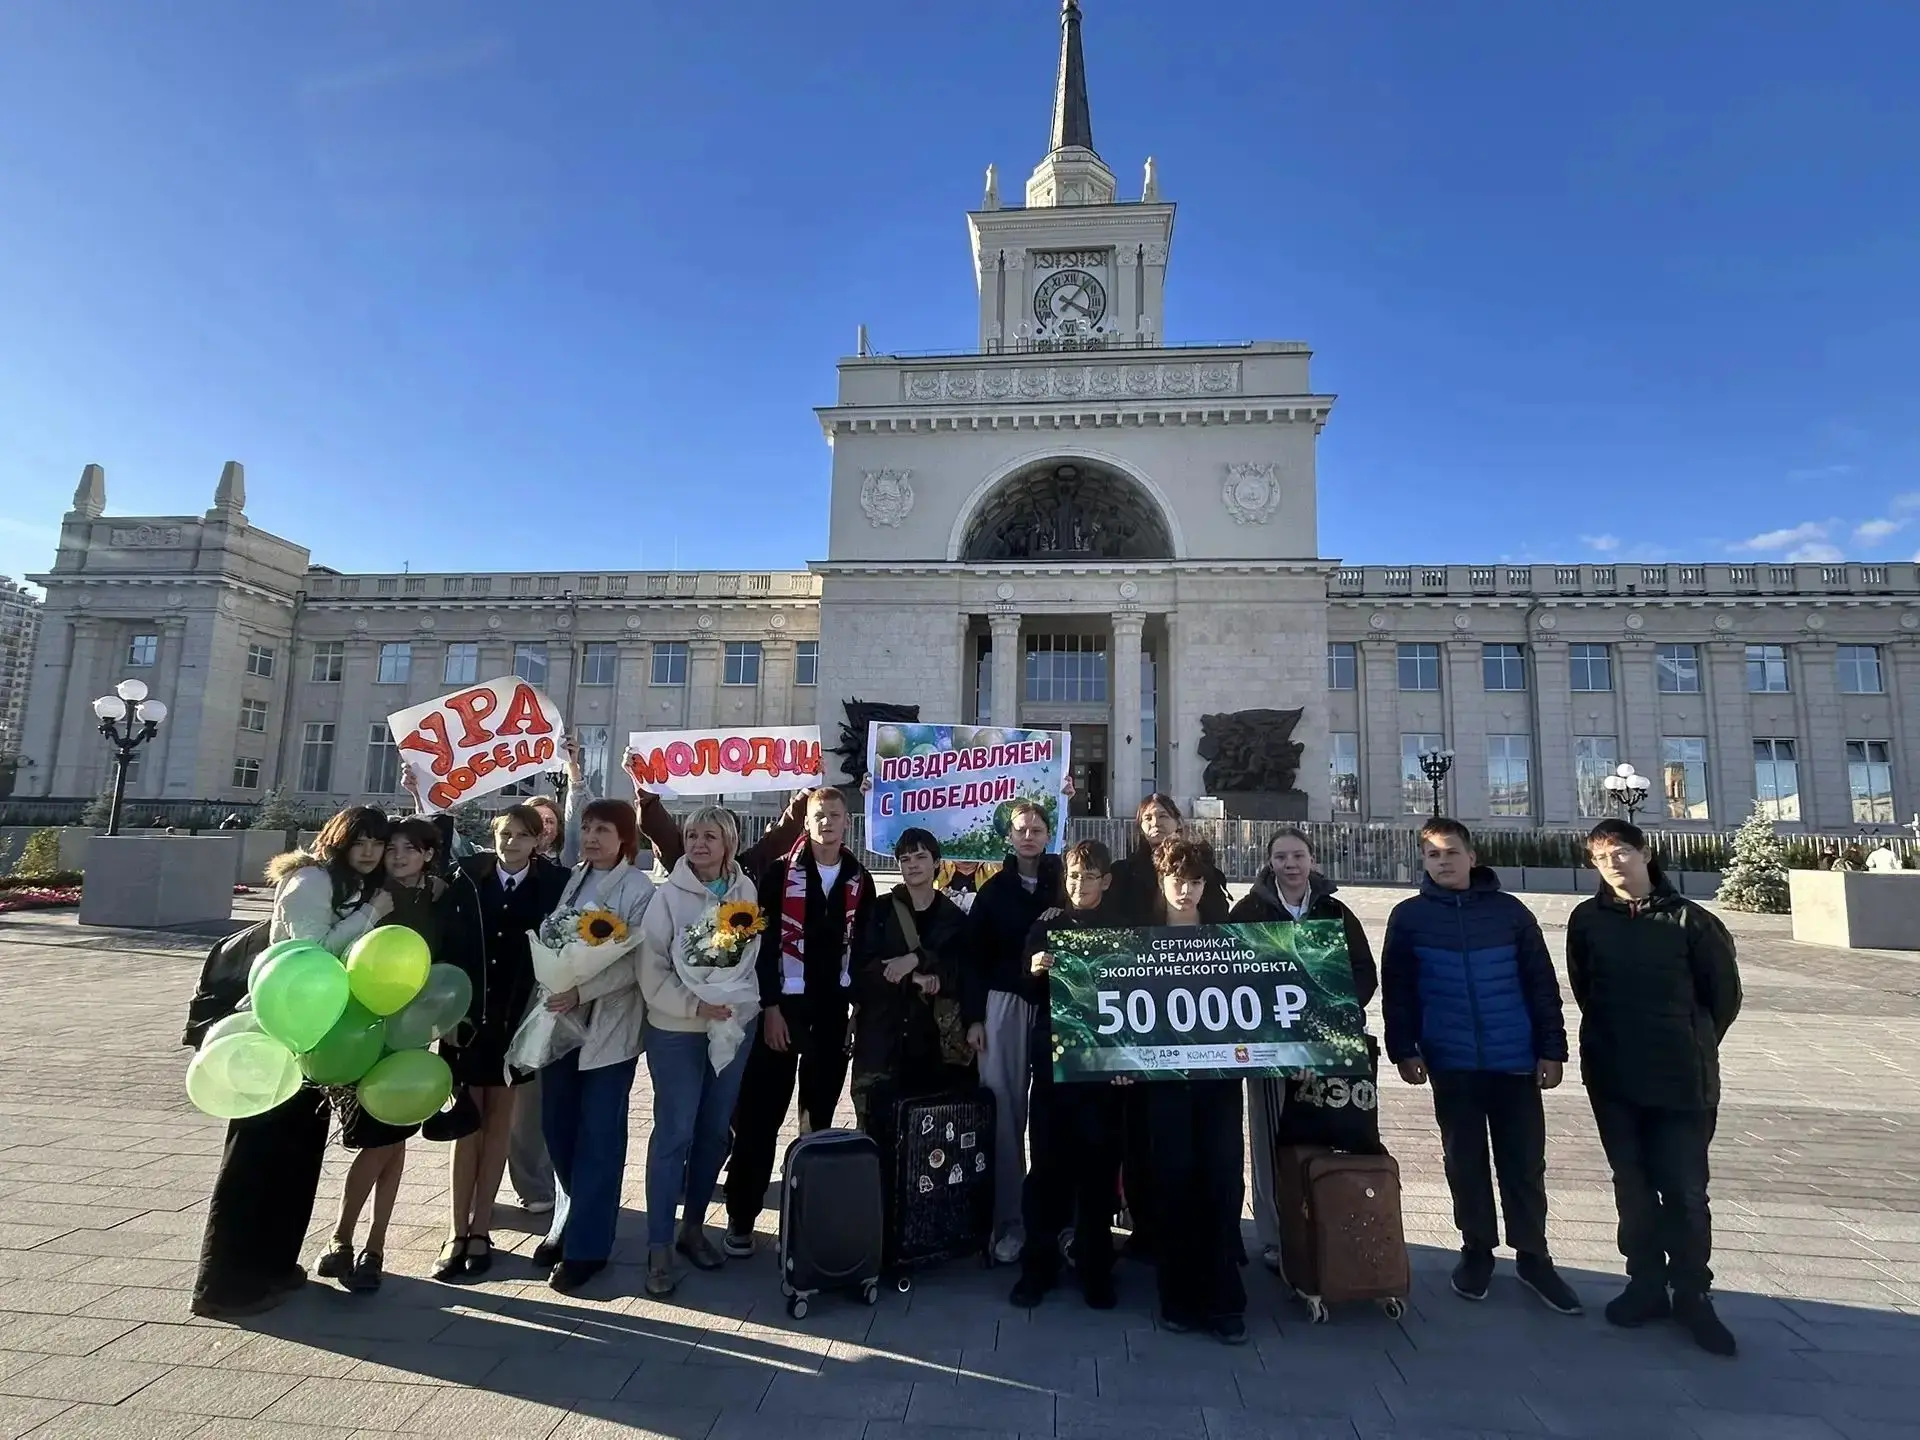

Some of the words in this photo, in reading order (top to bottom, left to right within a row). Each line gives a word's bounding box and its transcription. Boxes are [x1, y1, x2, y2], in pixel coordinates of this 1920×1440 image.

[400, 683, 553, 776] УРА
[631, 736, 822, 784] МОЛОДЦЫ
[882, 739, 1052, 782] ПОЗДРАВЛЯЕМ
[881, 793, 893, 816] С
[902, 775, 1016, 814] ПОБЕДОЙ!
[1136, 953, 1156, 964] НА
[1160, 949, 1256, 963] РЕАЛИЗАЦИЮ
[1151, 937, 1237, 951] СЕРТИФИКАТ
[1100, 963, 1229, 979] ЭКОЛОГИЧЕСКОГО
[1233, 961, 1298, 974] ПРОЕКТА
[1096, 989, 1157, 1035] 50
[1166, 985, 1263, 1033] 000
[1273, 984, 1308, 1029] ₽
[1159, 1050, 1180, 1058] ДЭФ
[1187, 1050, 1228, 1060] КОМПАС
